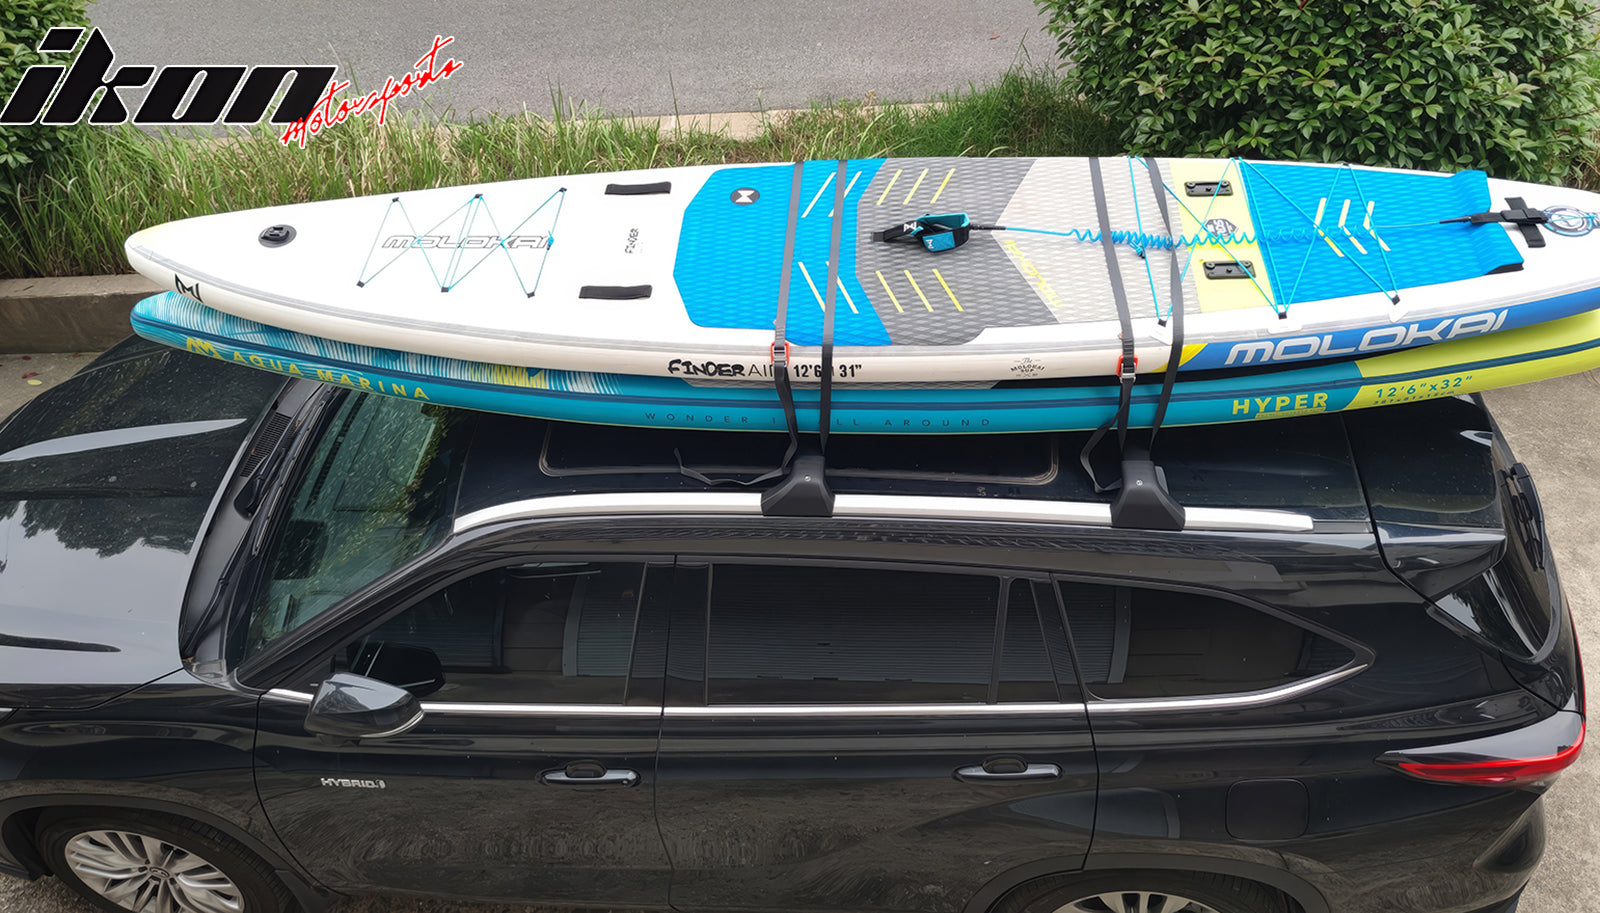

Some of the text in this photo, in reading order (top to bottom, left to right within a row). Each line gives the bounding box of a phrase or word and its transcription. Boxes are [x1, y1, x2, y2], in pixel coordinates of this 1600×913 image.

[1224, 309, 1508, 365] MOLOKAI
[233, 350, 430, 400] AQUA MARINA
[667, 358, 745, 377] FINDER
[1232, 392, 1329, 415] HYPER
[644, 412, 748, 424] WONDER
[320, 777, 379, 789] HYBRID
